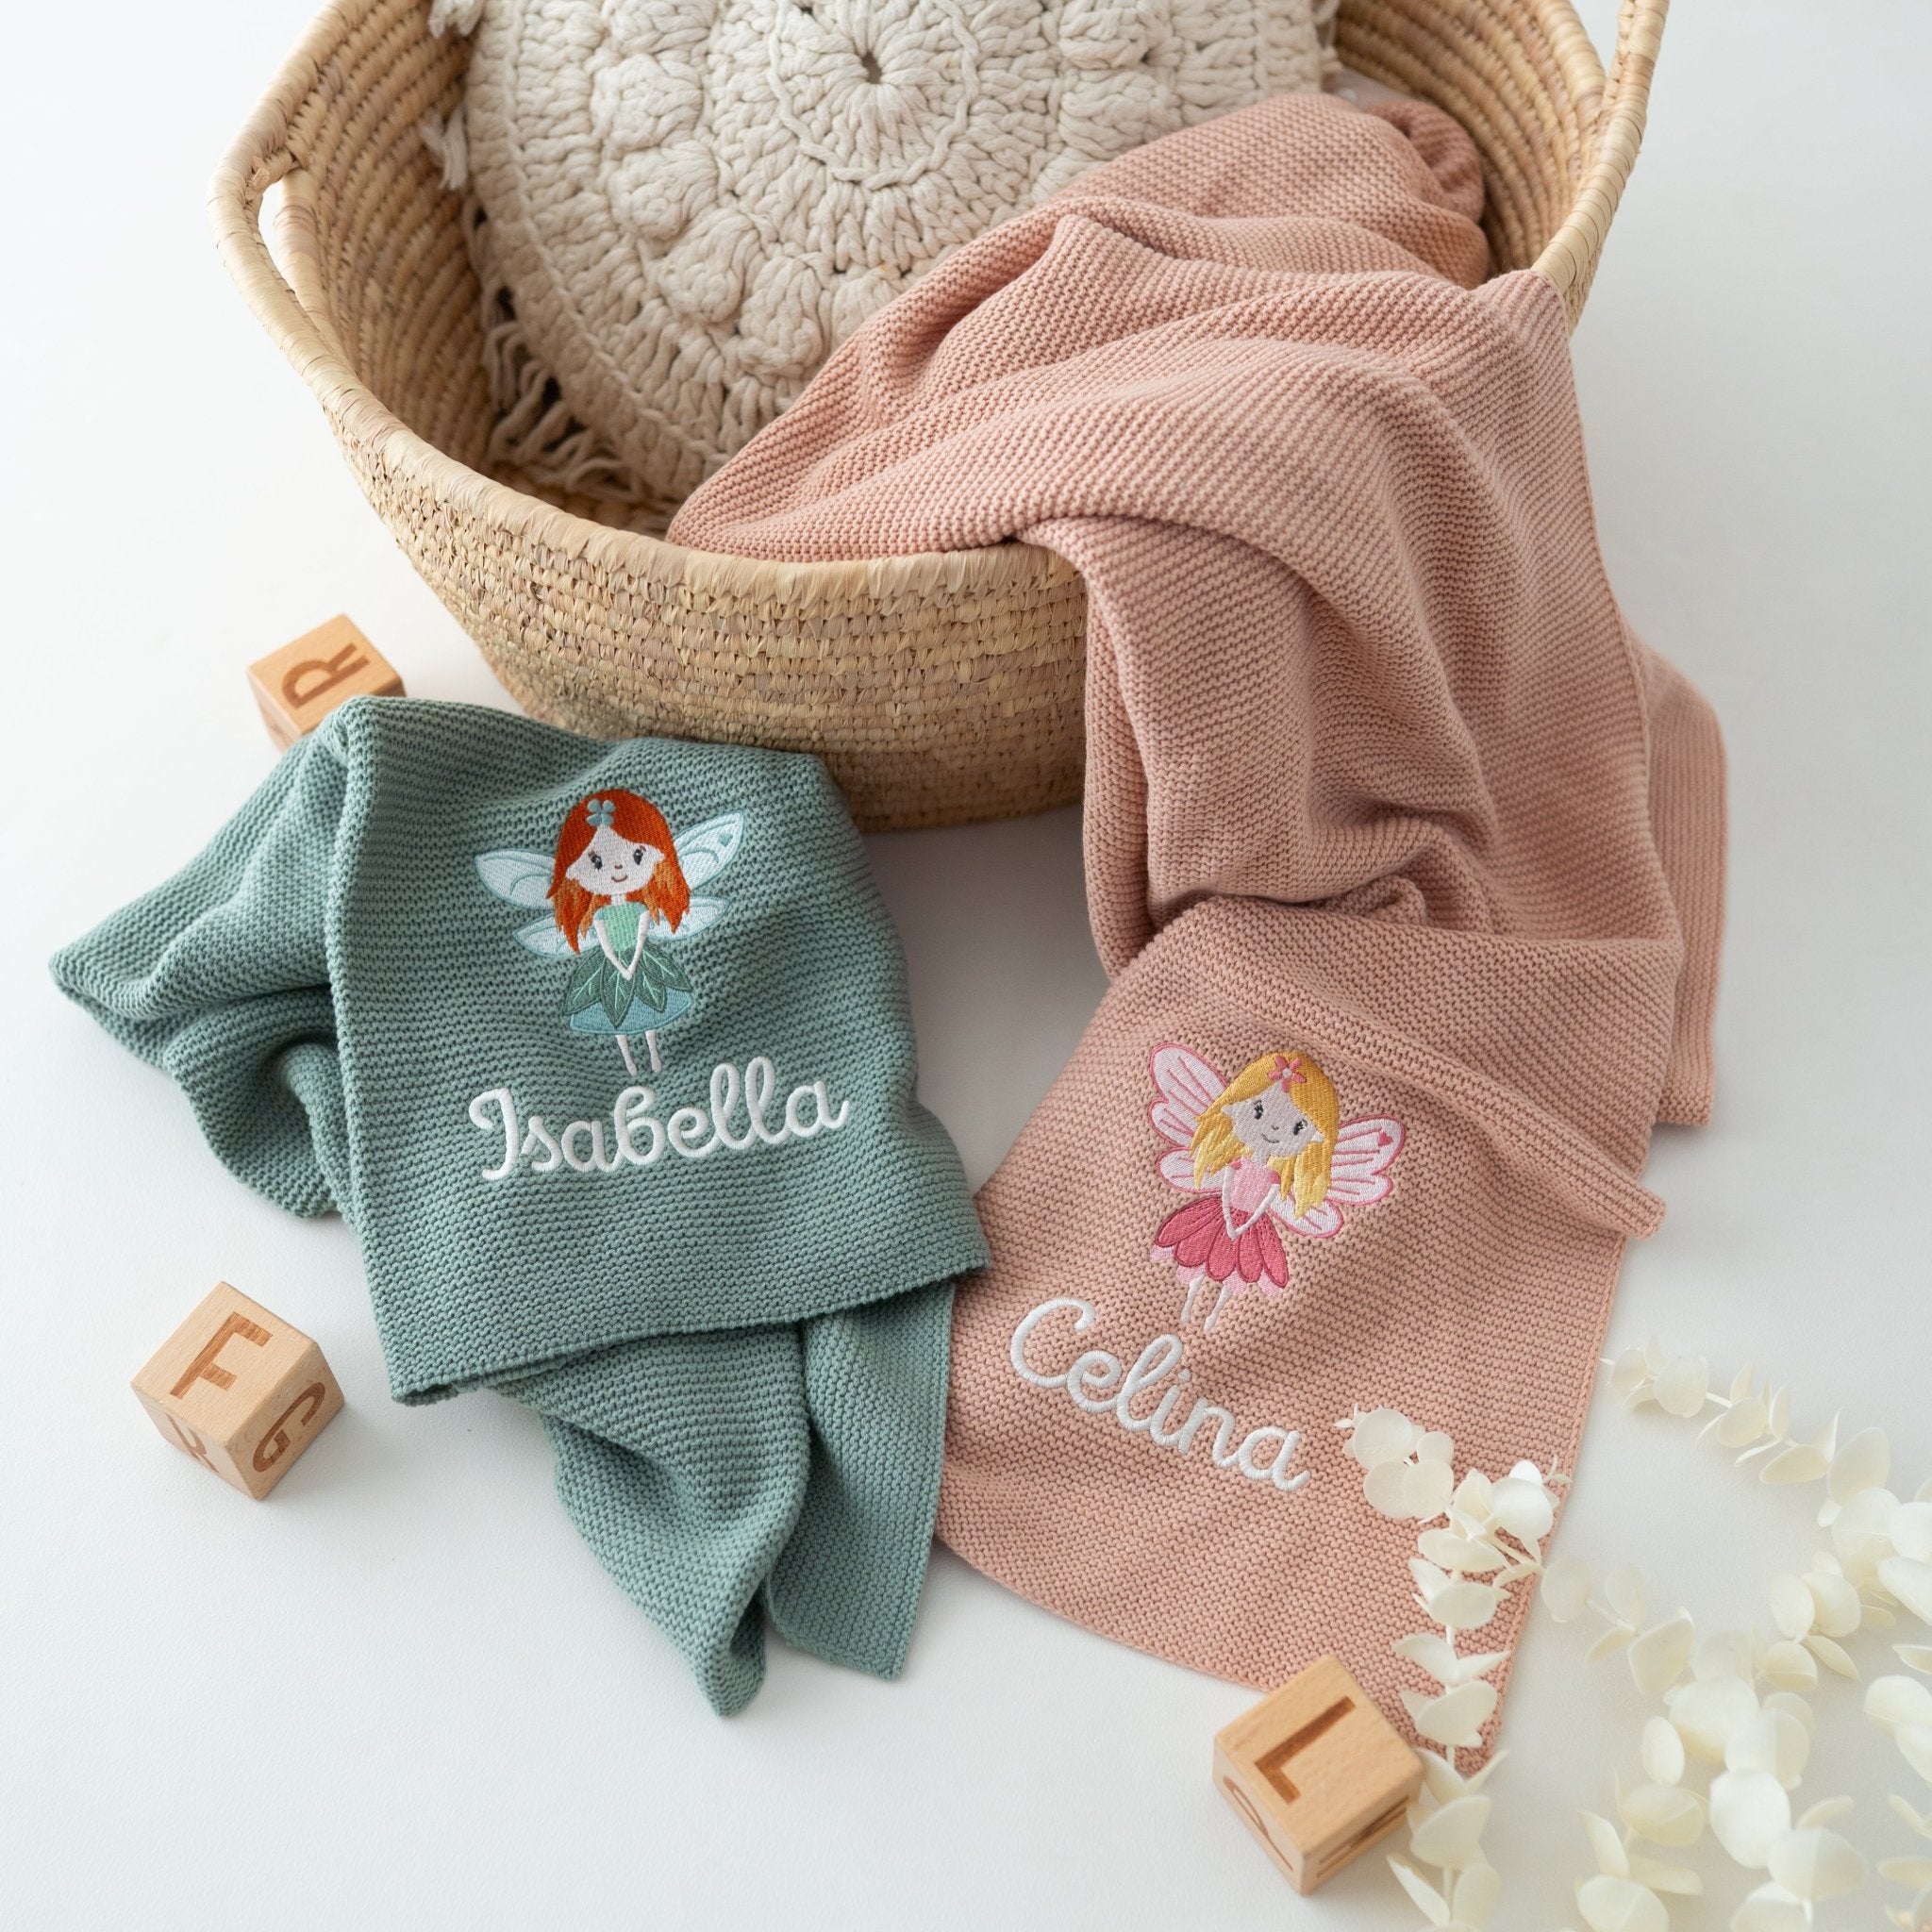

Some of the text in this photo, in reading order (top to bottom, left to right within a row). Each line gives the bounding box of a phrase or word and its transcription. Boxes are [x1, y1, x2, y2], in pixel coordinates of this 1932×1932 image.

[282, 642, 370, 710] R
[469, 1056, 850, 1180] Isabella
[169, 1310, 274, 1400] F
[1009, 1296, 1312, 1492] Celina
[252, 1381, 326, 1473] G
[1254, 1695, 1356, 1805] L
